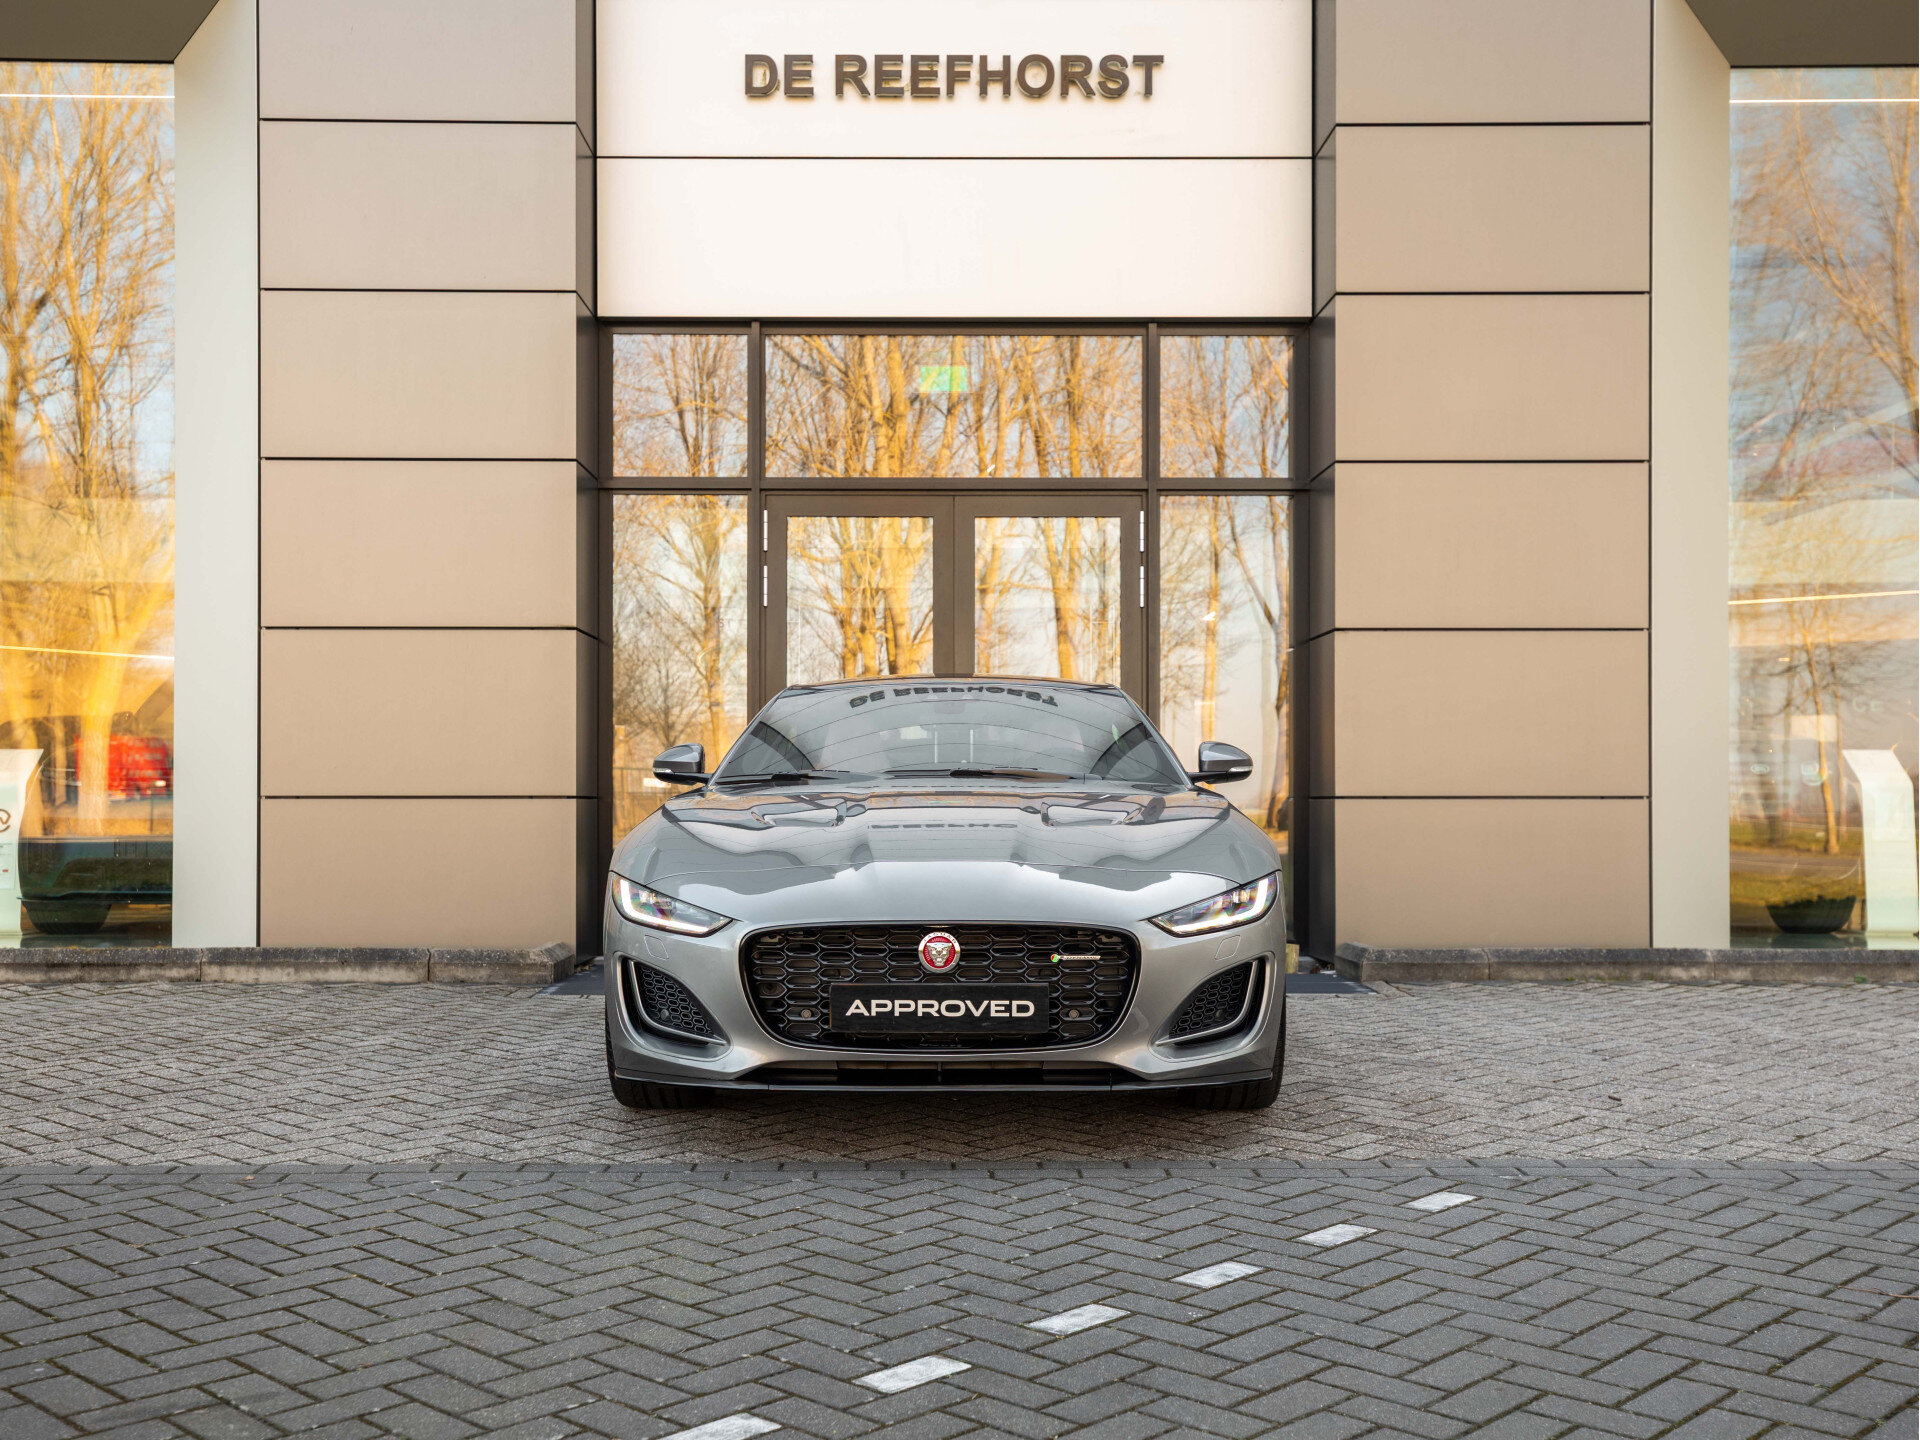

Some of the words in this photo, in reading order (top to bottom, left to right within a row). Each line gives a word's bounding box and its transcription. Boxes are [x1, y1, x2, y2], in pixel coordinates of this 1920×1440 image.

[744, 54, 814, 98] DE
[835, 54, 1165, 98] REEFHORST
[845, 999, 1035, 1018] APPROVED
